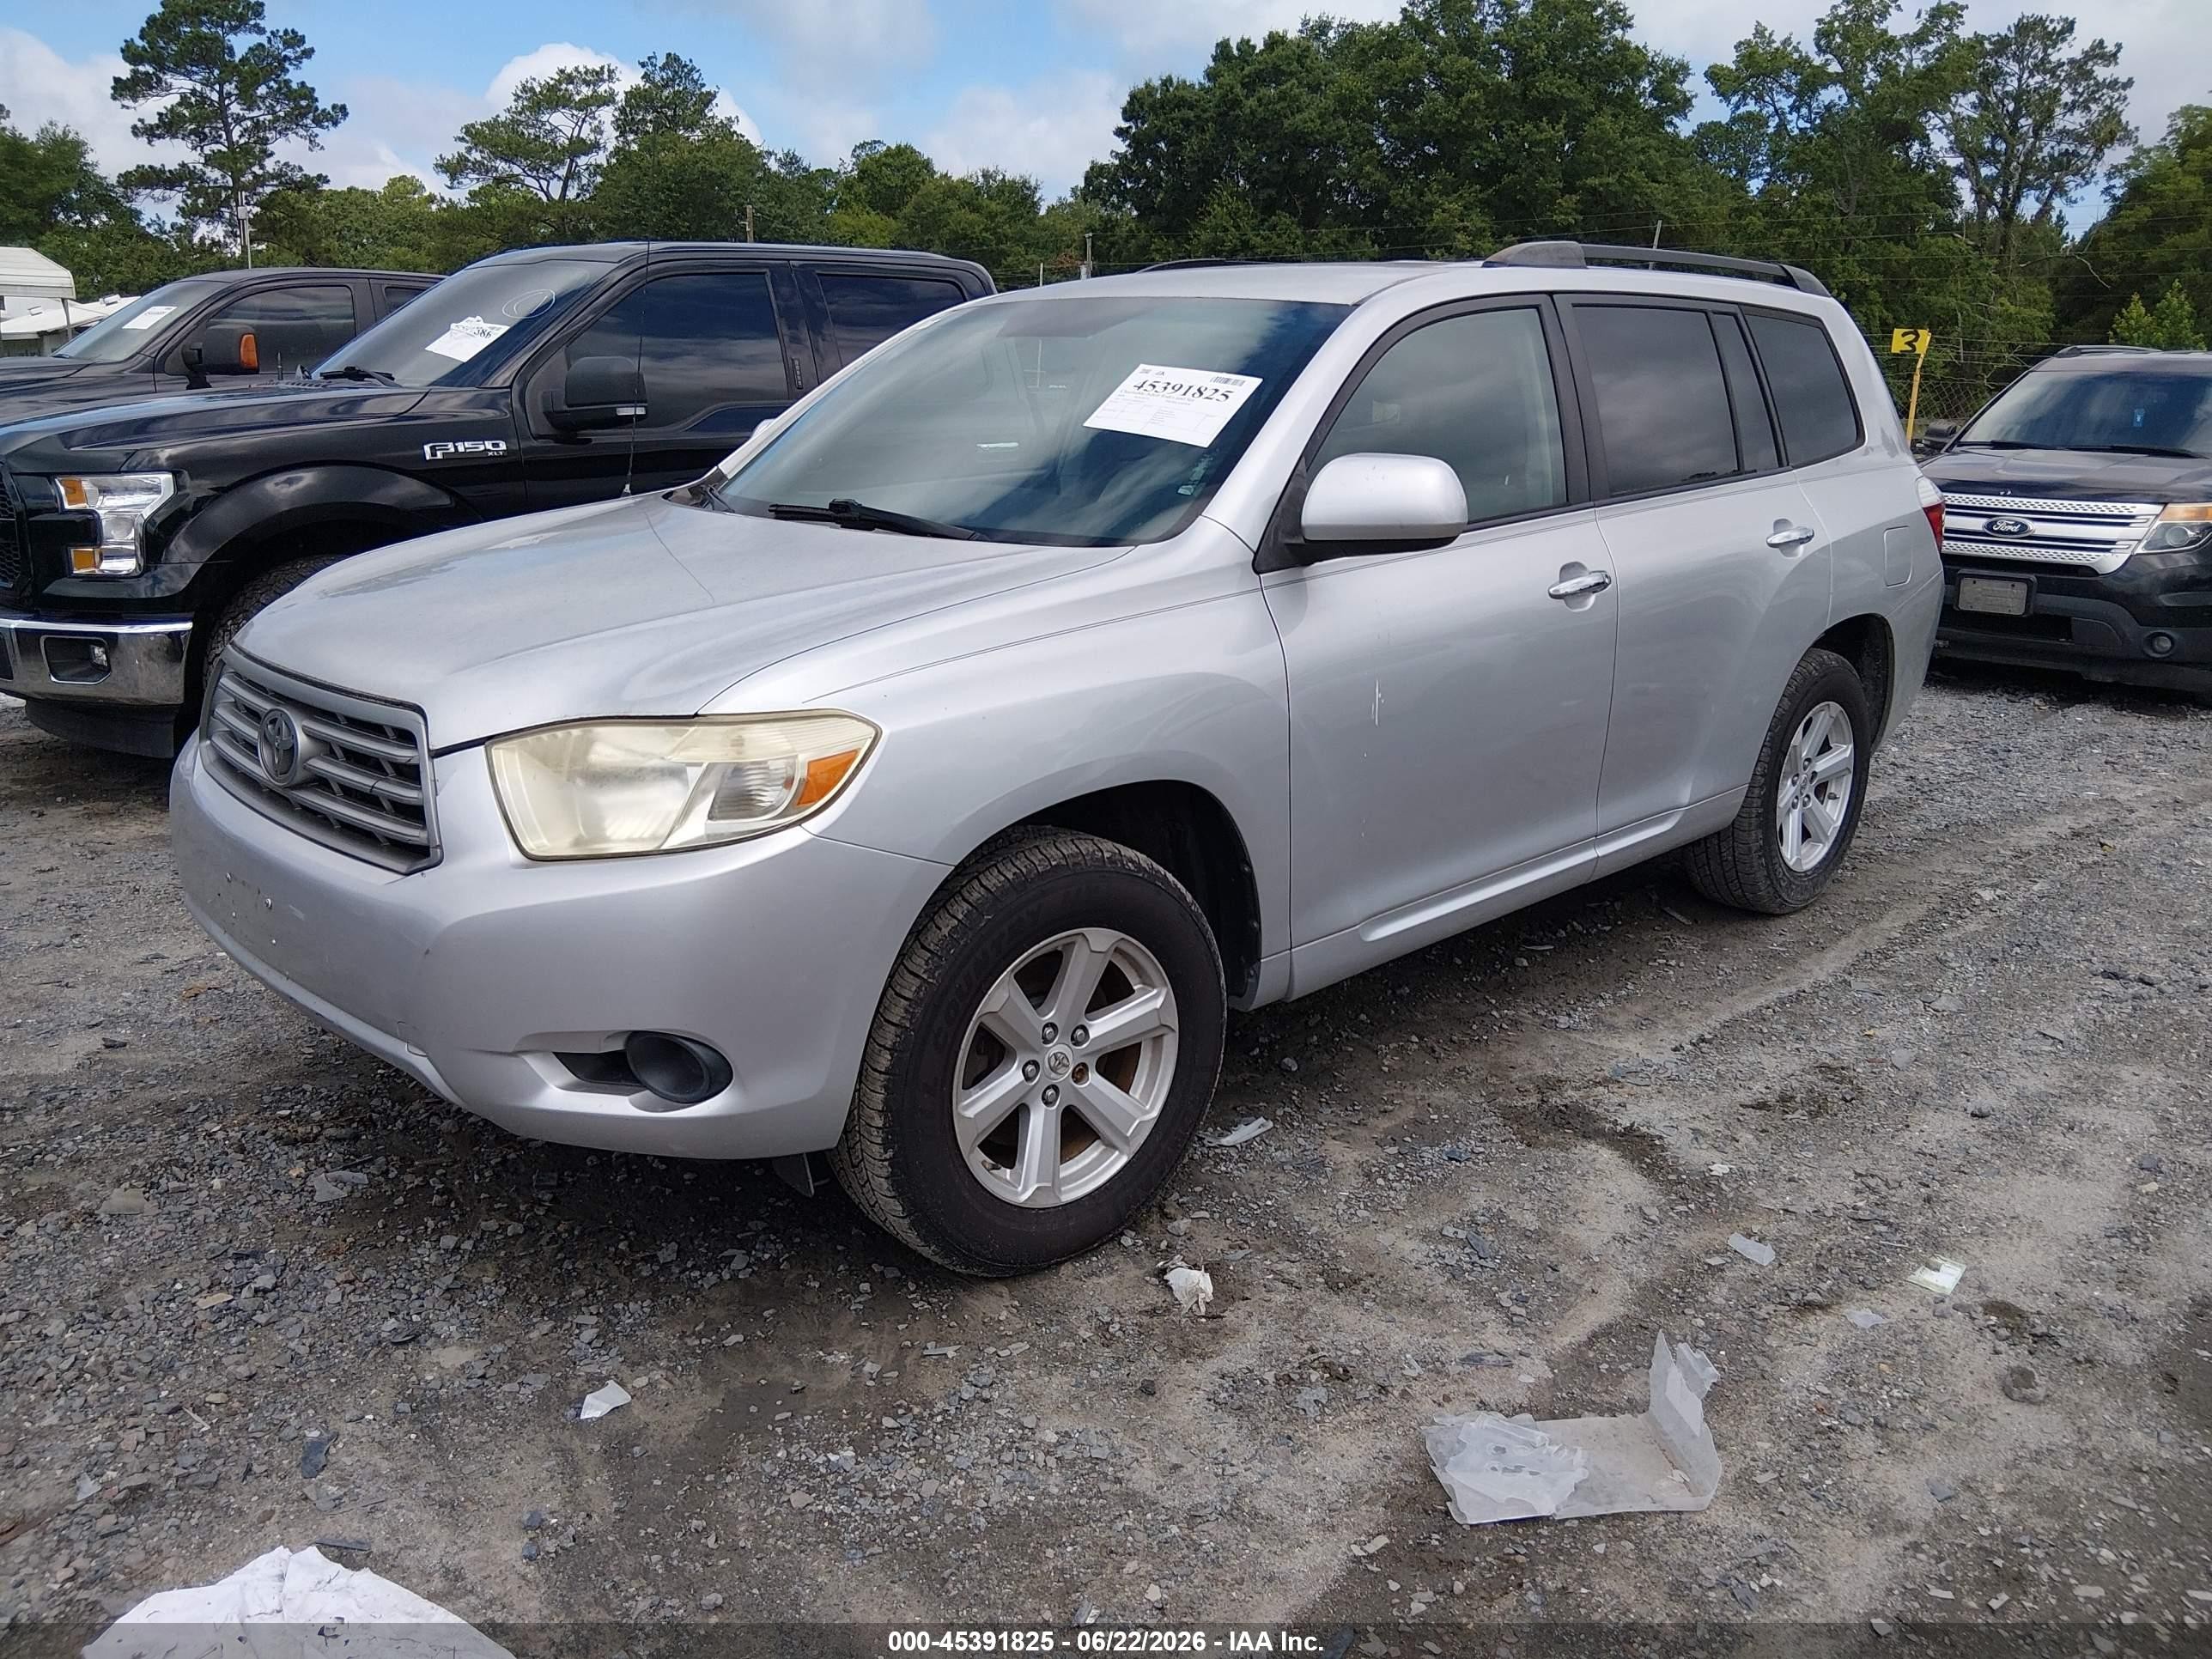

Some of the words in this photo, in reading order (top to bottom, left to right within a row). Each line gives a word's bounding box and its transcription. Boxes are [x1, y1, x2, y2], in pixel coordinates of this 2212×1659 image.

[1900, 330, 1920, 353] 3
[1133, 379, 1234, 402] 45391825
[1991, 520, 2021, 532] Ford
